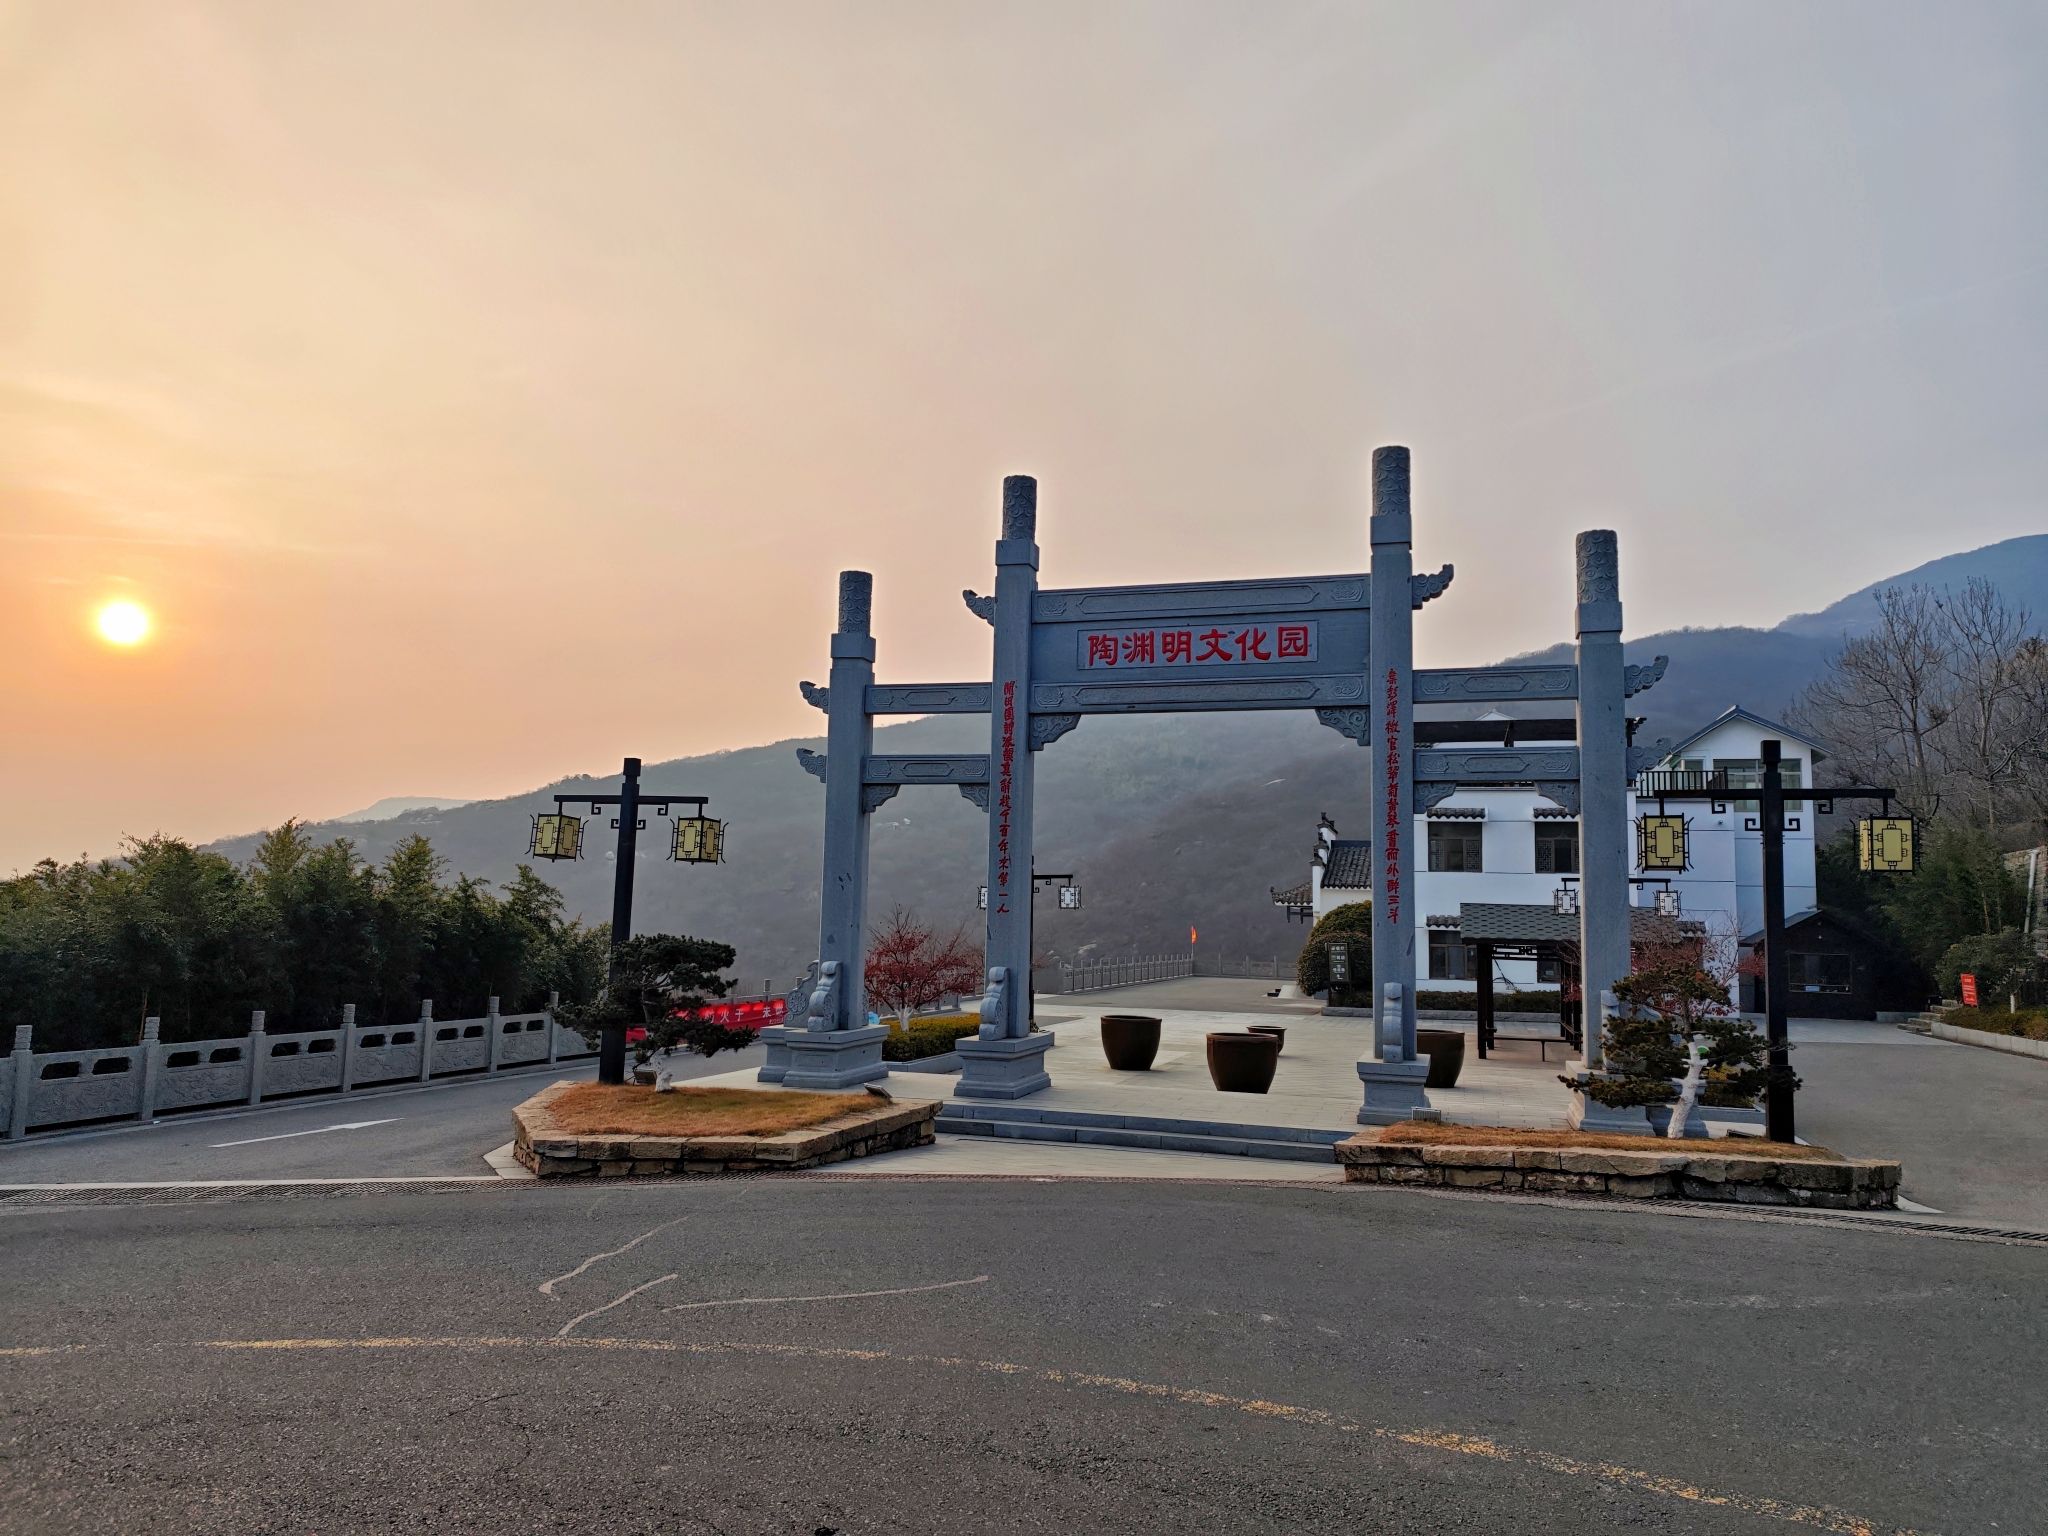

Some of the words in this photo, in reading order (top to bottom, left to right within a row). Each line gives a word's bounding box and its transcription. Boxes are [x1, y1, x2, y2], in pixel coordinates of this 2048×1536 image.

[1089, 626, 1310, 665] 陶渊明文化园
